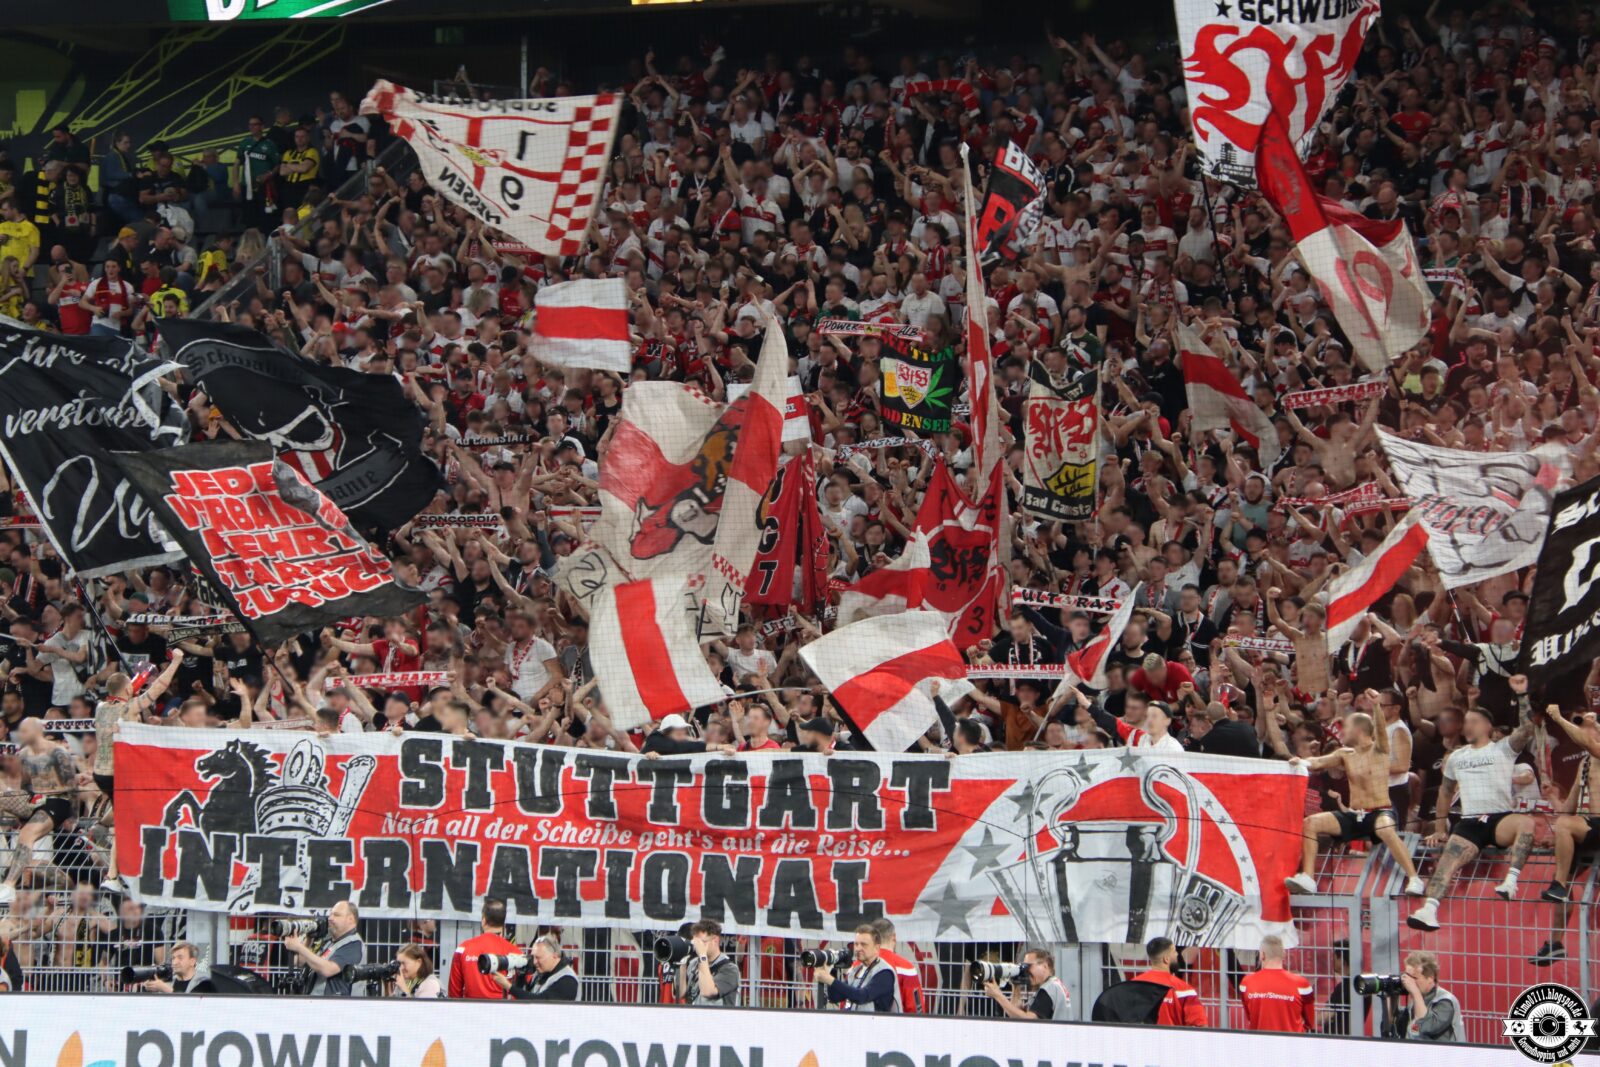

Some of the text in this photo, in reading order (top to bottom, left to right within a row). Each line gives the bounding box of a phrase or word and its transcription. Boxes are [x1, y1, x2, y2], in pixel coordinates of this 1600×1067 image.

[401, 736, 952, 832] STUTTGART
[138, 823, 887, 933] INTERNATIONAL
[381, 811, 911, 857] Nach all der Scheiße geht's auf die Reise...
